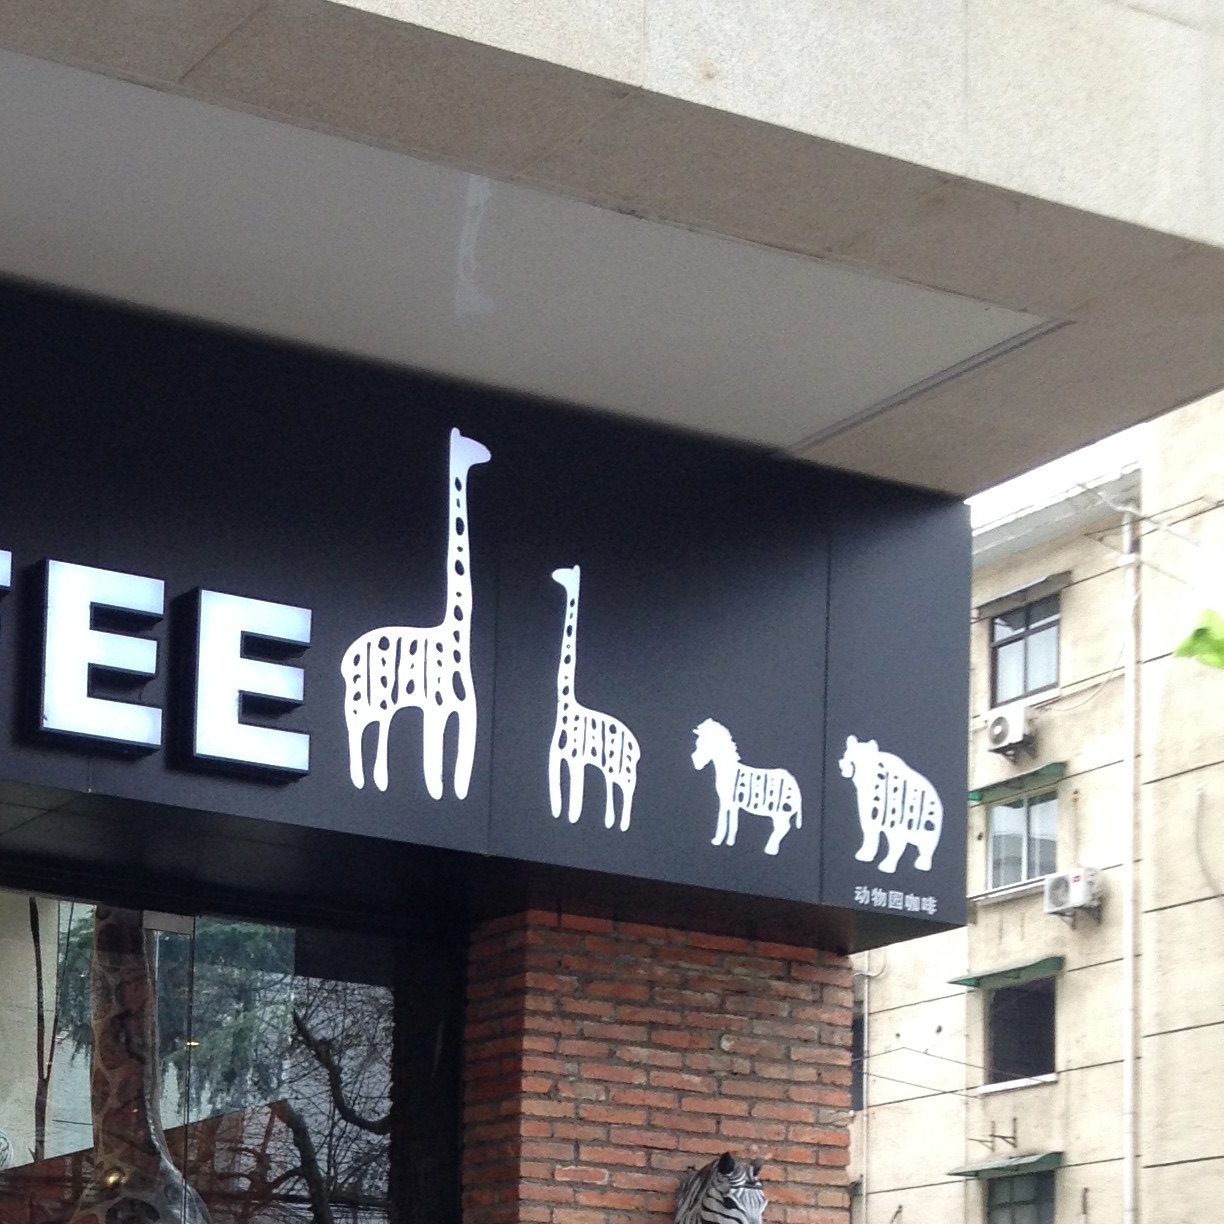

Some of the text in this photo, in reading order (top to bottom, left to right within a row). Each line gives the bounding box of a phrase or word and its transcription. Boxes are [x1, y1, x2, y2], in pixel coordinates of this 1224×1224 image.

[854, 885, 938, 916] 动物园咖啡
